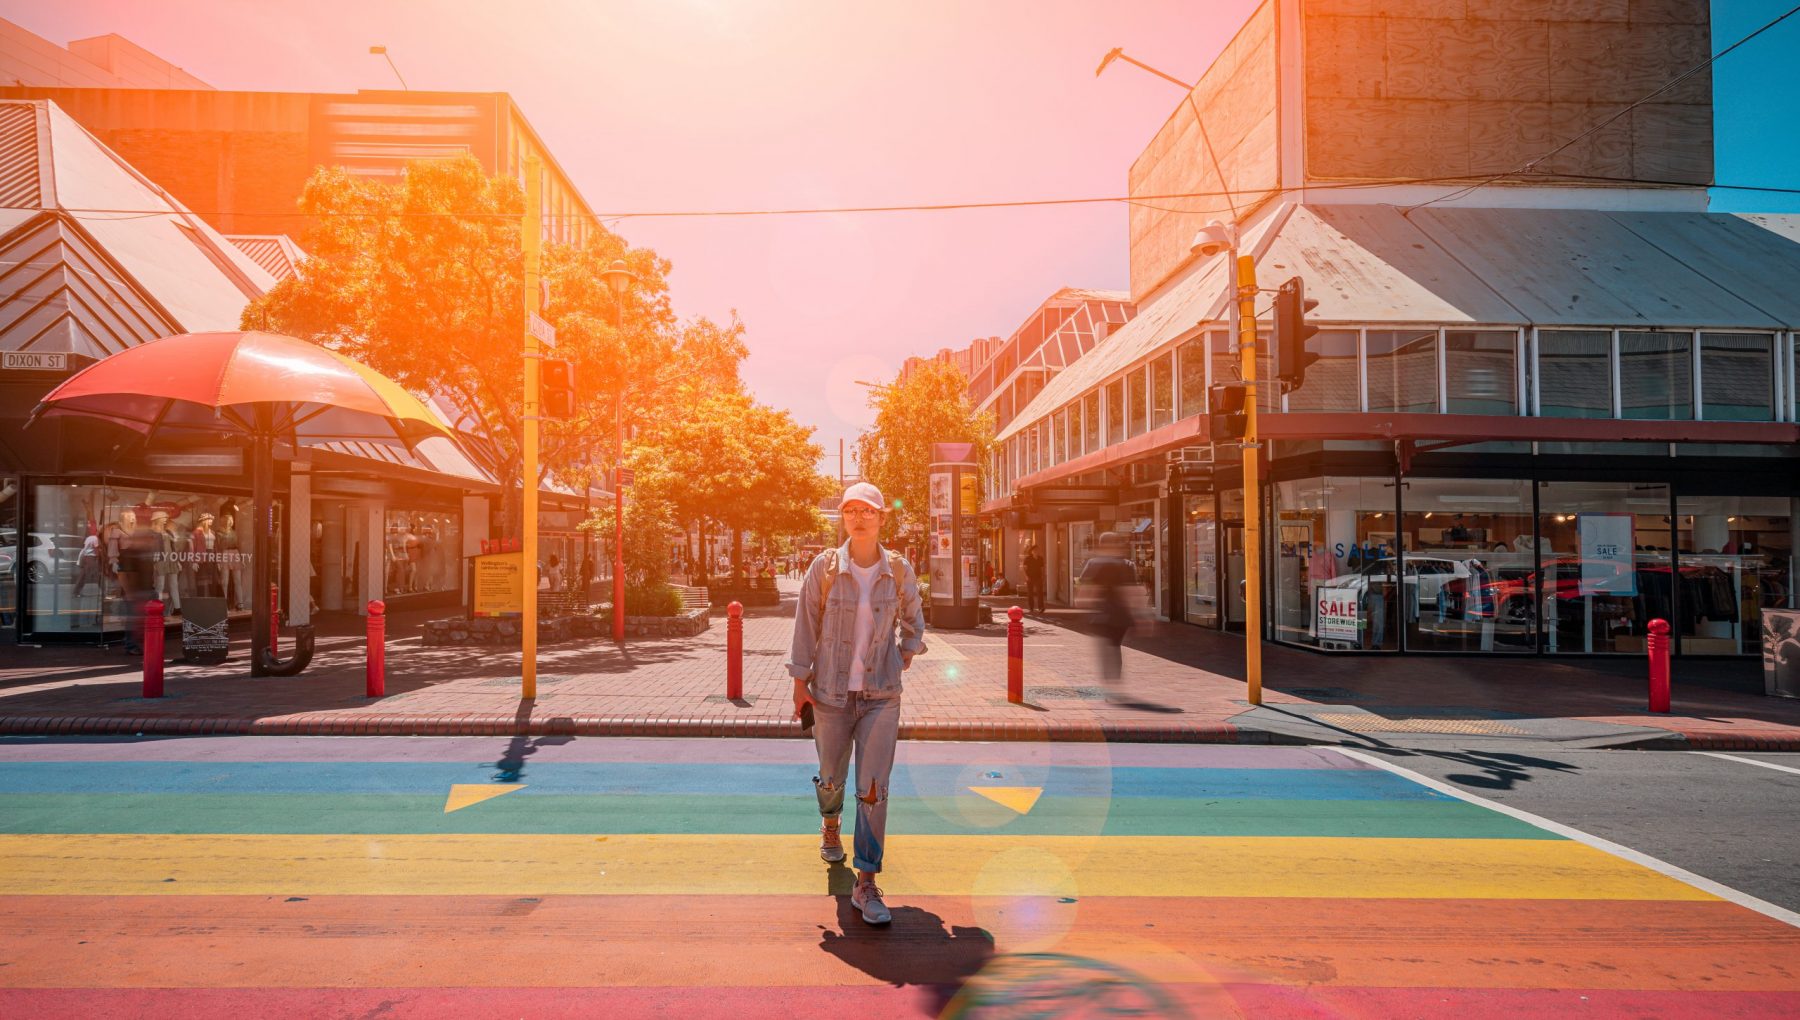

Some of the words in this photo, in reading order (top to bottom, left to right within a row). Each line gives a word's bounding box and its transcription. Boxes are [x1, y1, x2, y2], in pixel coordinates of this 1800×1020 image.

[9, 354, 42, 367] DIXON
[48, 355, 62, 368] ST
[1336, 543, 1389, 558] SALE
[1596, 547, 1617, 555] SALE
[153, 552, 253, 563] #YOURSTREETSTY
[1320, 600, 1356, 617] SALE
[1319, 617, 1356, 626] STOREWIDE
